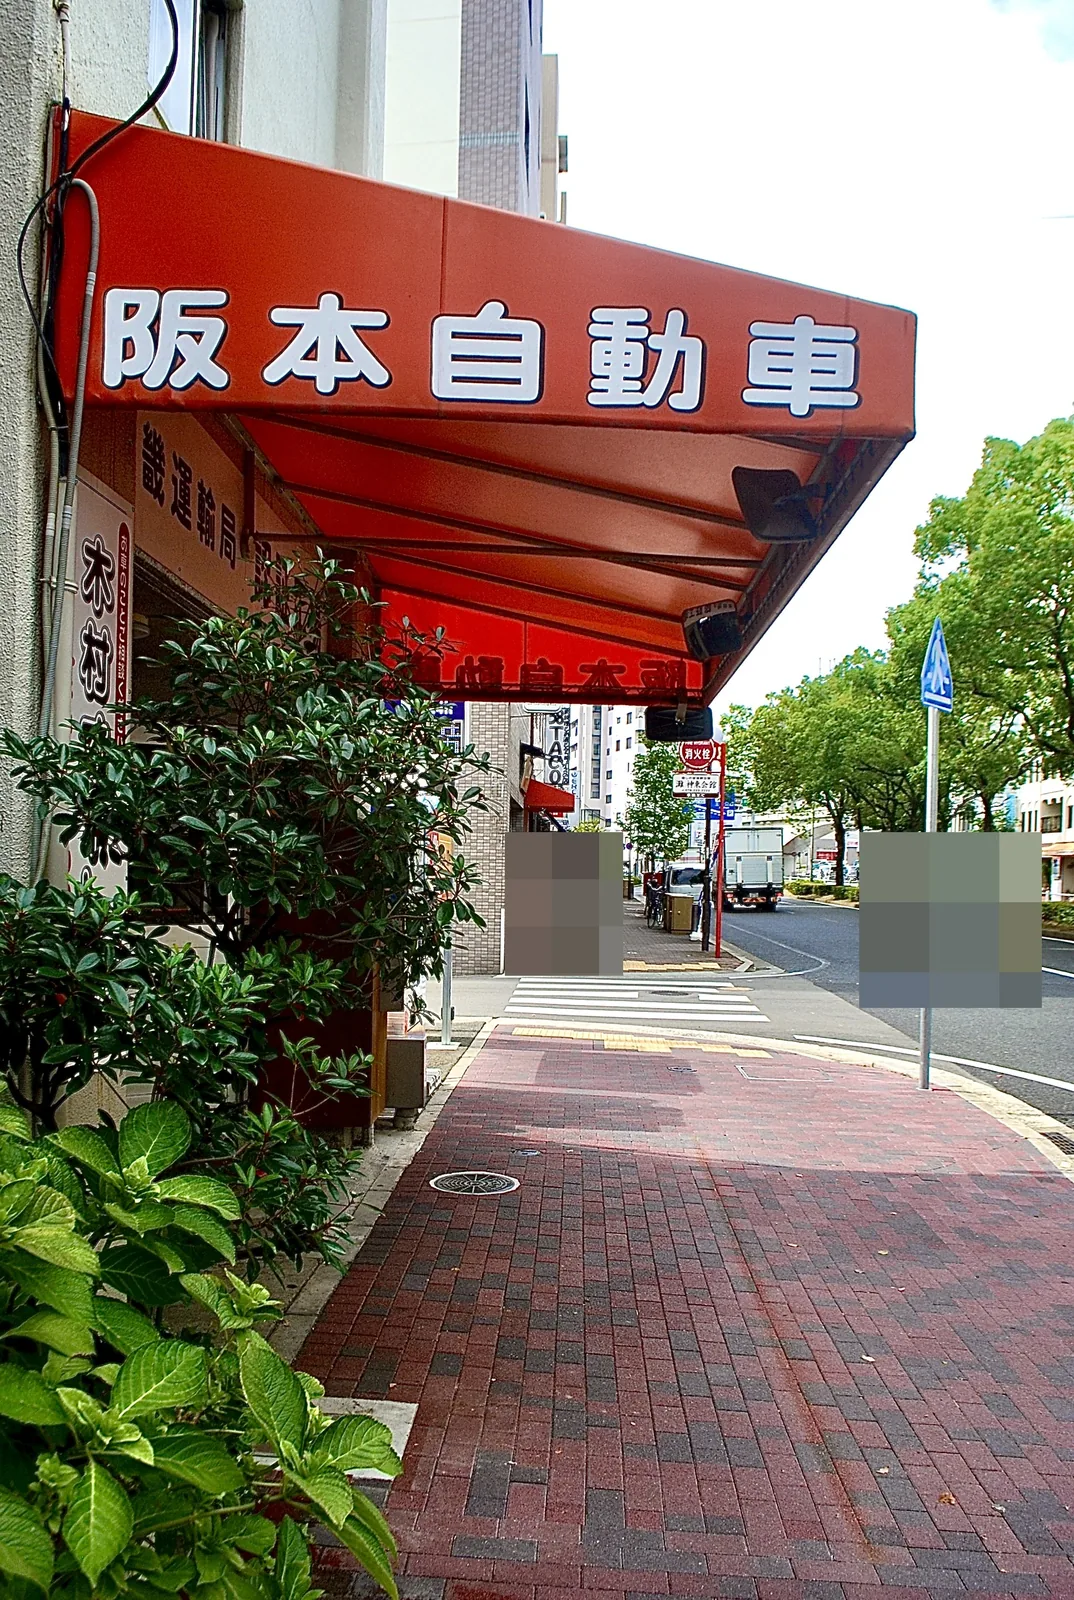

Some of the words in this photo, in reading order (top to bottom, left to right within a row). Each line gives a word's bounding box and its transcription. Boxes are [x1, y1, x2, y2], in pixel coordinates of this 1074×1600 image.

[101, 286, 861, 416] 阪本自動車
[684, 748, 711, 760] 消火栓
